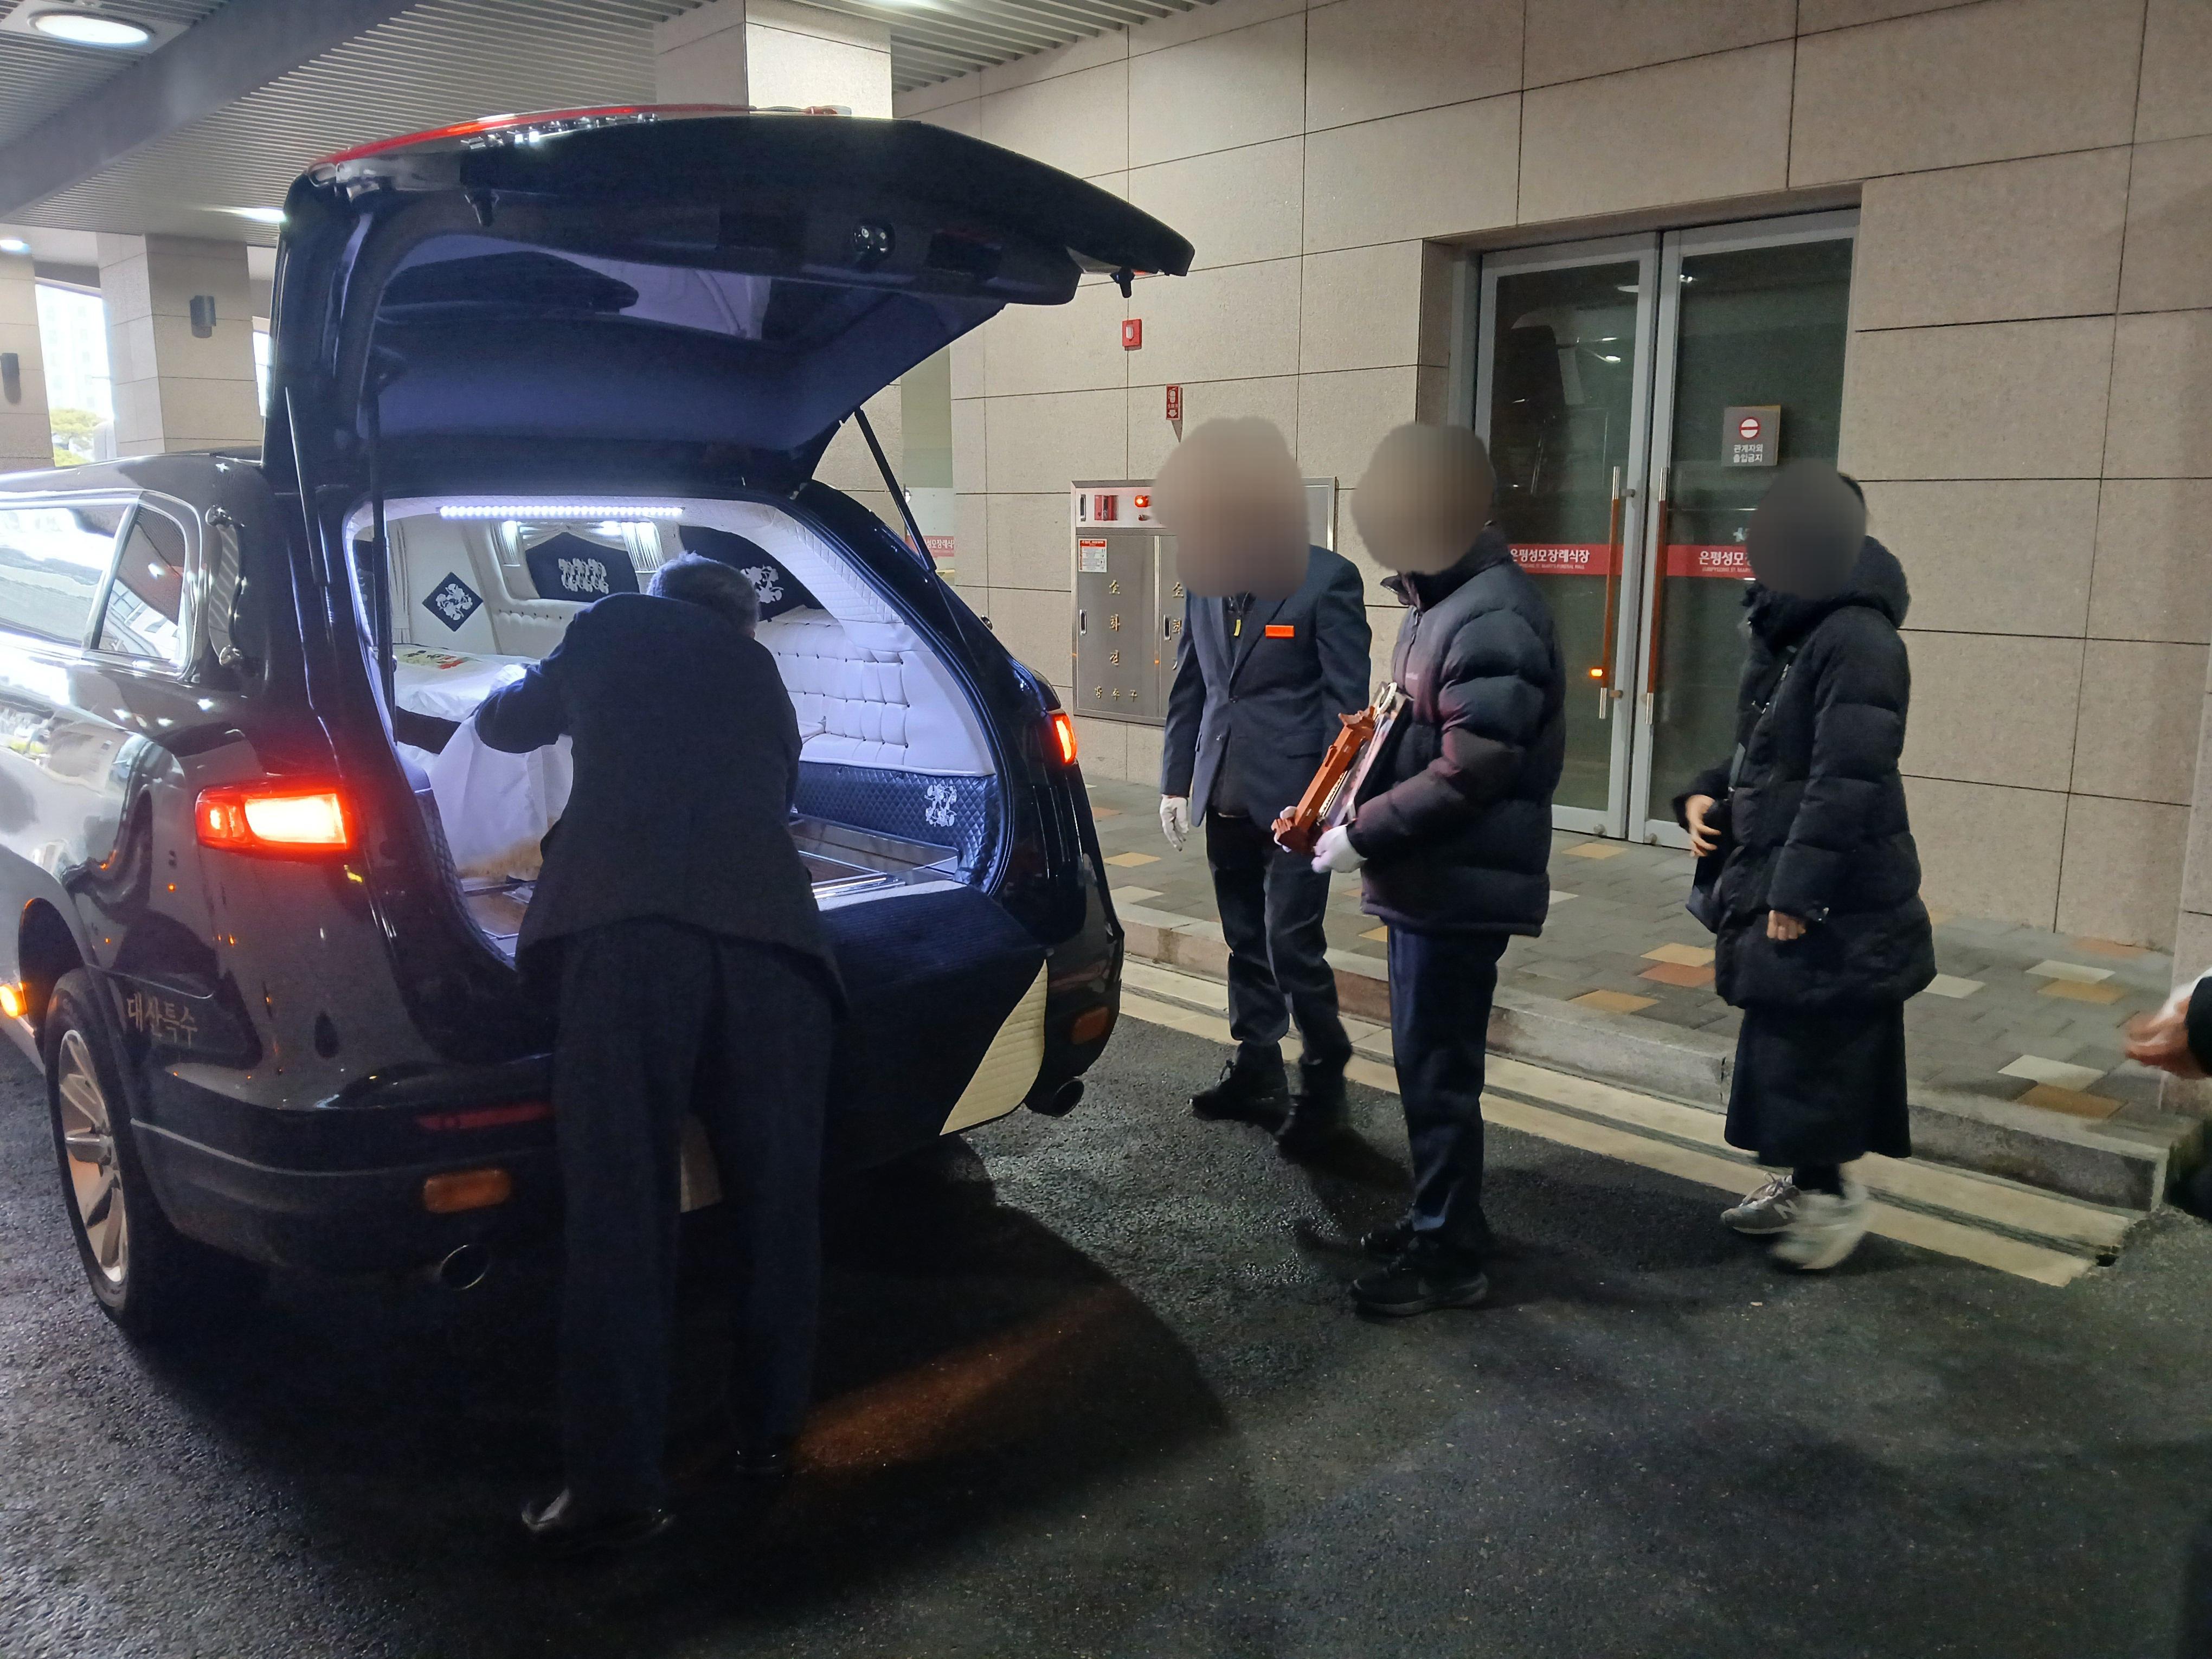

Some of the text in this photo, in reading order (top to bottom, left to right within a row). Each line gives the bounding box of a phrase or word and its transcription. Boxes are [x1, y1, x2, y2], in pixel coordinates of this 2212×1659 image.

[1734, 443, 1763, 453] 관계자외
[1733, 453, 1763, 462] 출입금지
[1510, 549, 1590, 563] 은평성모장례식장
[1699, 551, 1752, 566] 은평성모
[127, 992, 198, 1048] 대산특수
